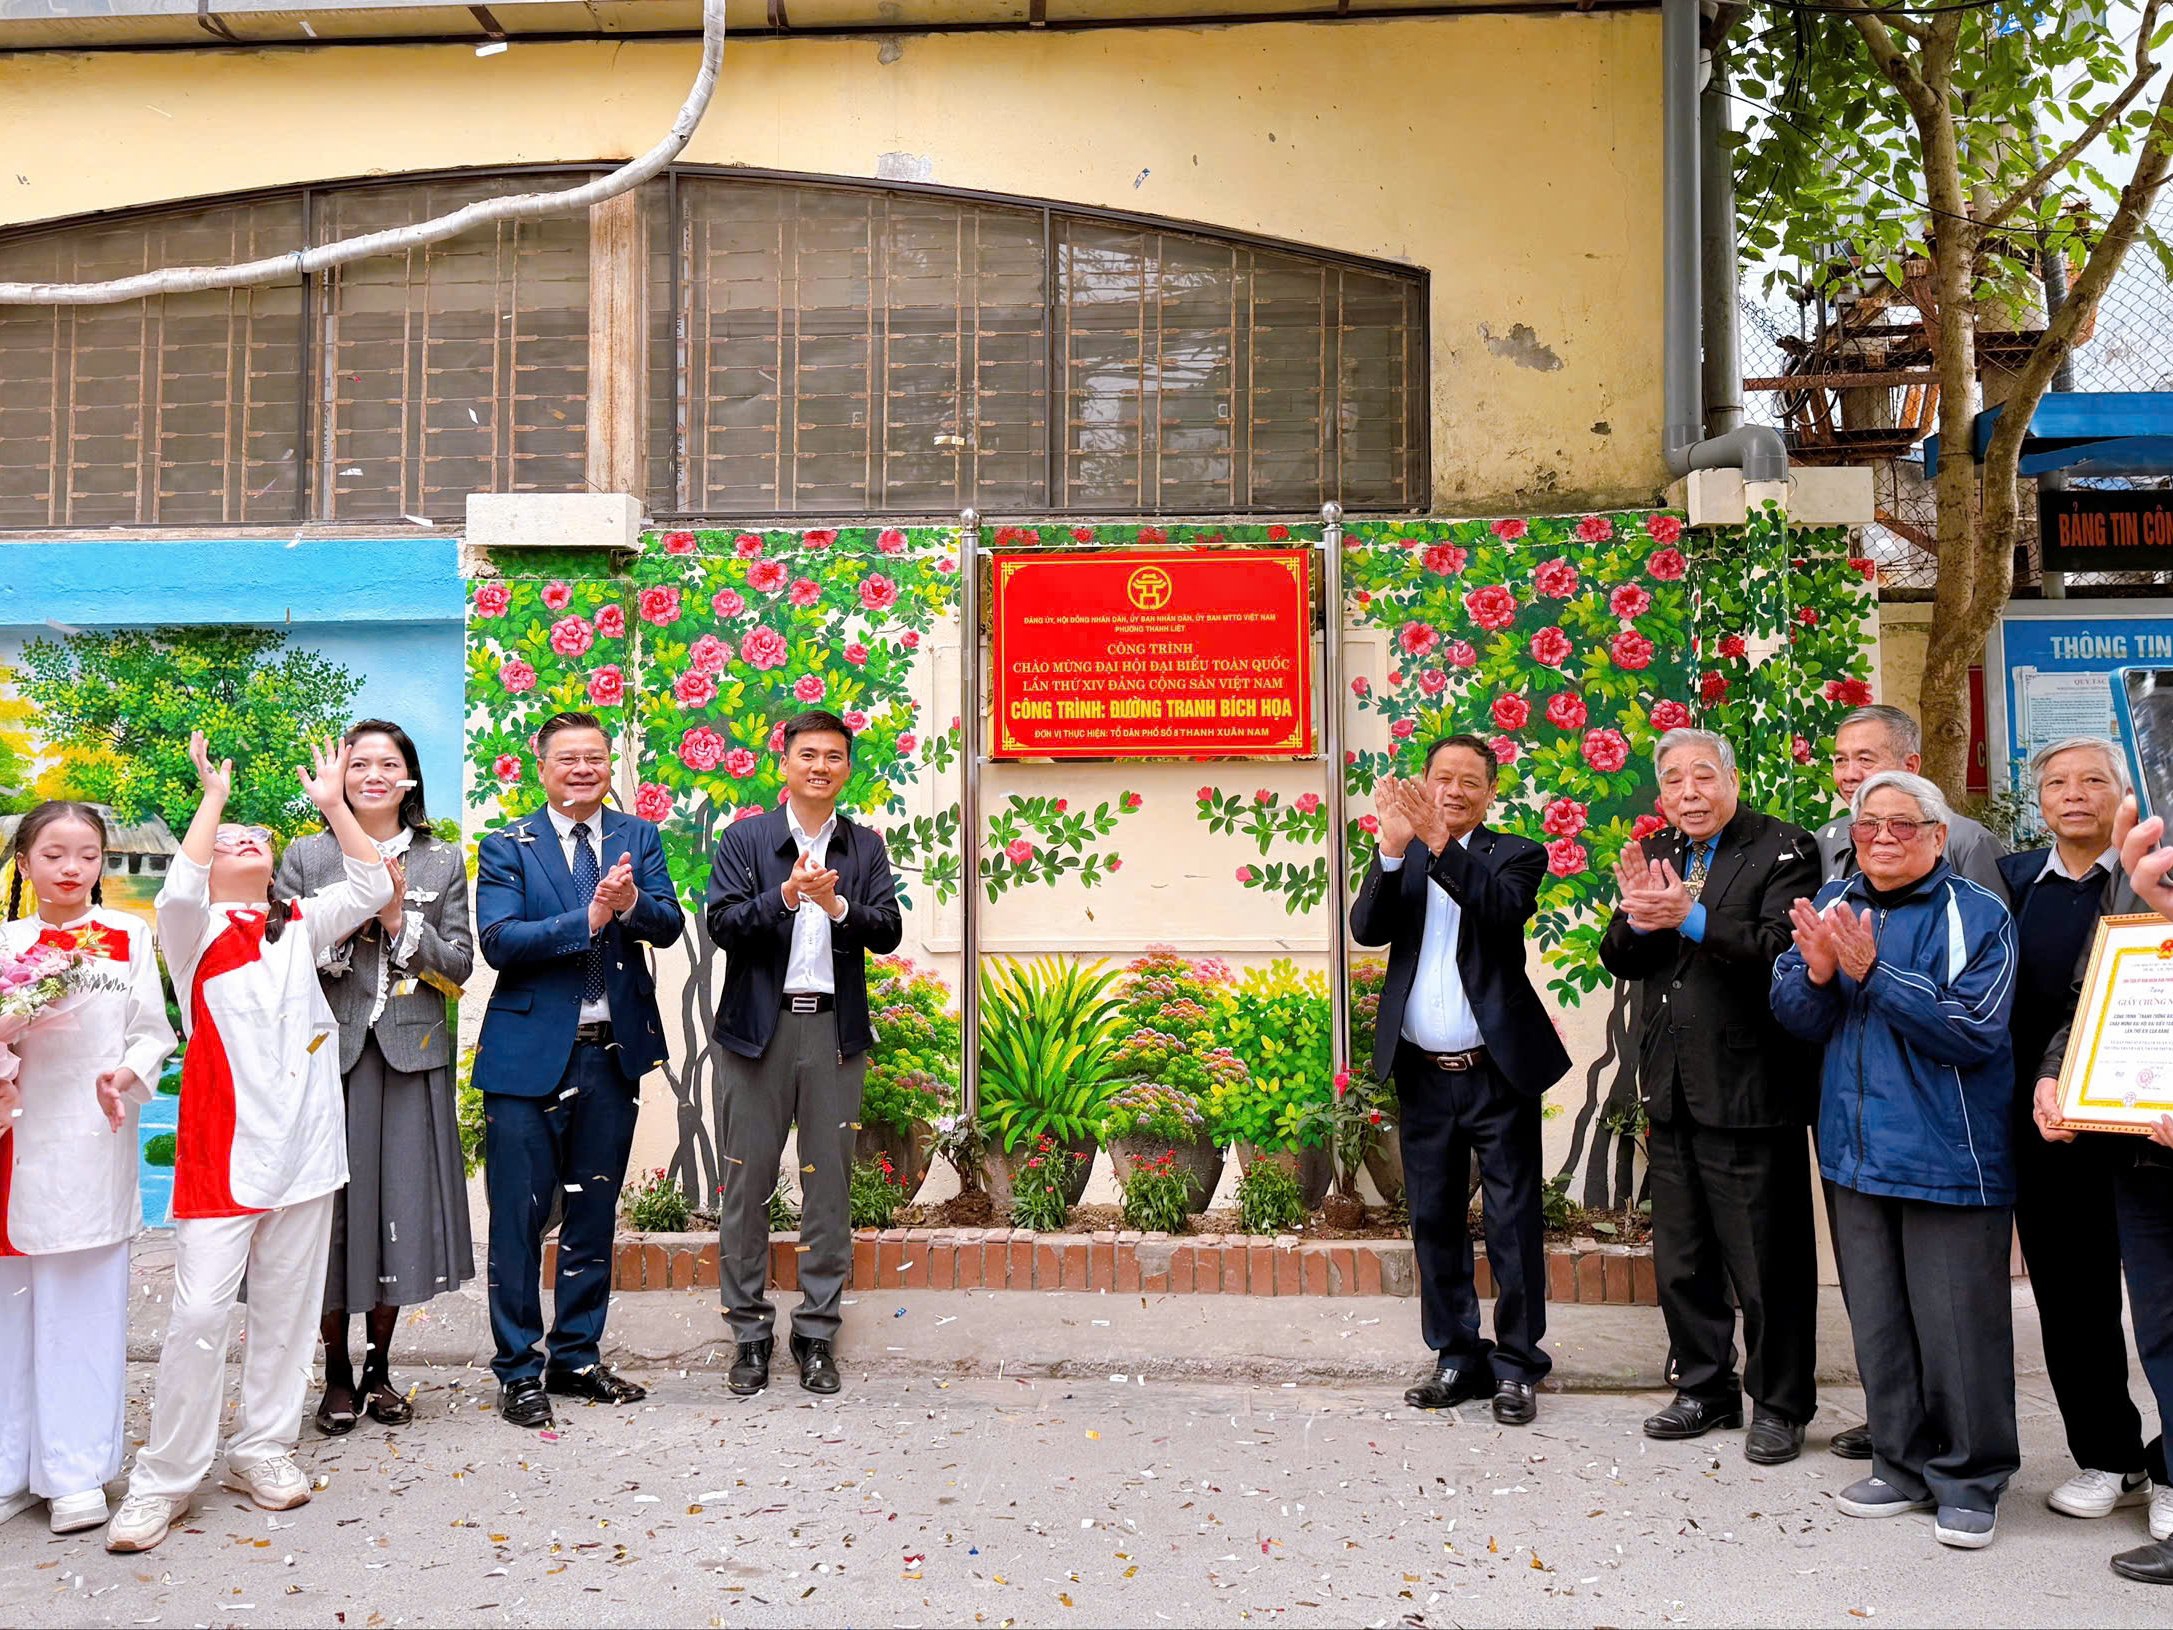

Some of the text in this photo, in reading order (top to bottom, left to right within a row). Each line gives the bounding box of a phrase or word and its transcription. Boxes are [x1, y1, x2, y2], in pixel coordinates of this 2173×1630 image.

[2058, 501, 2107, 547] BẢNG
[2109, 512, 2139, 546] TIN
[1057, 616, 1069, 624] HỘI
[1091, 615, 1111, 623] NHÂN
[1140, 615, 1155, 623] BAN
[1156, 614, 1176, 622] NHÂN
[1243, 613, 1259, 621] VIỆT
[1107, 641, 1193, 655] CÔNG TRÌNH
[2050, 630, 2172, 660] THÔNG TIN
[1013, 655, 1290, 674] CHÀO MỪNG ĐẠI HỘI ĐẠI BIỂU TOÀN QUỐC
[1023, 674, 1283, 692] LẦN THỨ XIV ĐẢNG CỘNG SẢN VIỆT NAM
[1011, 695, 1293, 721] CÔNG TRÌNH: ĐƯỜNG TRANH BÍCH HỌA
[1034, 729, 1052, 739] ĐƠN
[1054, 729, 1062, 740] VỊ
[1063, 729, 1085, 739] THỰC
[1111, 725, 1122, 737] TỔ
[1123, 727, 1140, 737] DÂN
[1142, 725, 1159, 737] PHỐ
[1161, 725, 1173, 737] SỐ
[1179, 728, 1215, 737] THANH
[1217, 727, 1245, 737] XUÂN
[1247, 727, 1270, 736] NAM
